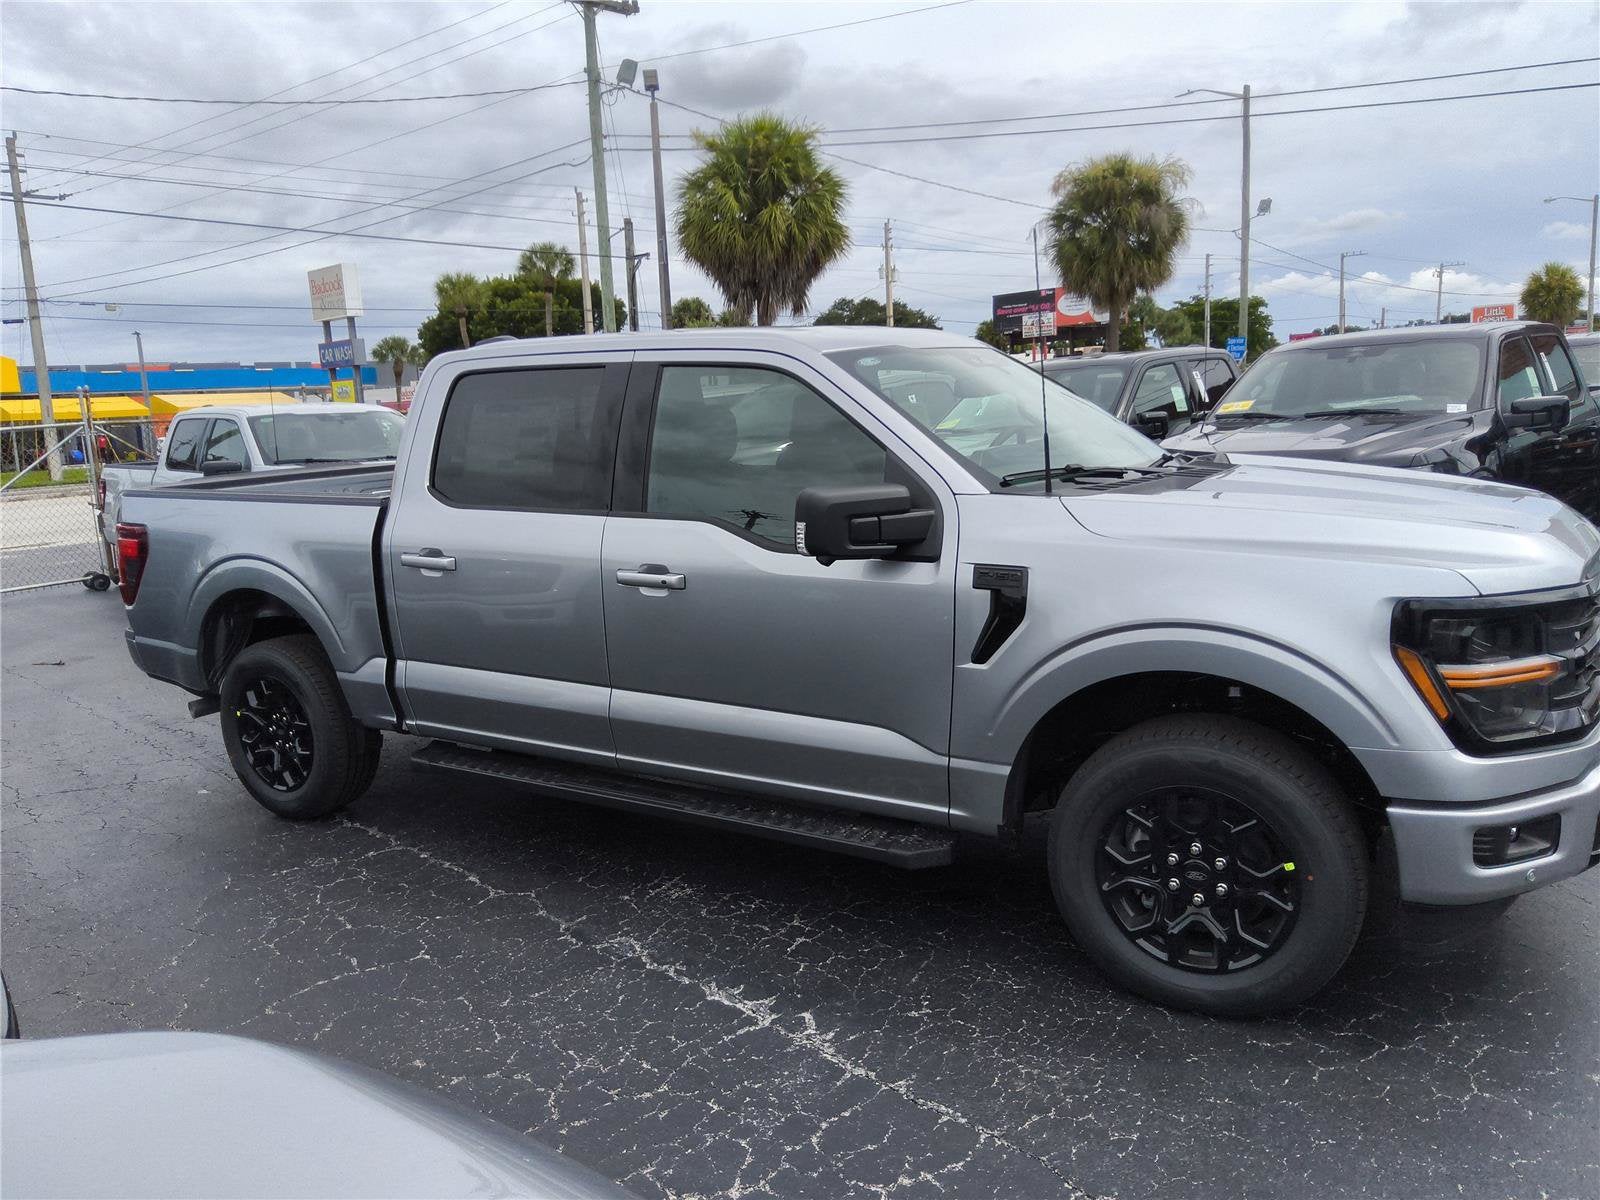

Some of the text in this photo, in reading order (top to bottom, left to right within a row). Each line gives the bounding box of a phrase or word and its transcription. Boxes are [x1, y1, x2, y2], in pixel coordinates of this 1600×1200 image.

[1484, 307, 1505, 316] Little
[320, 345, 353, 363] CAR WASH
